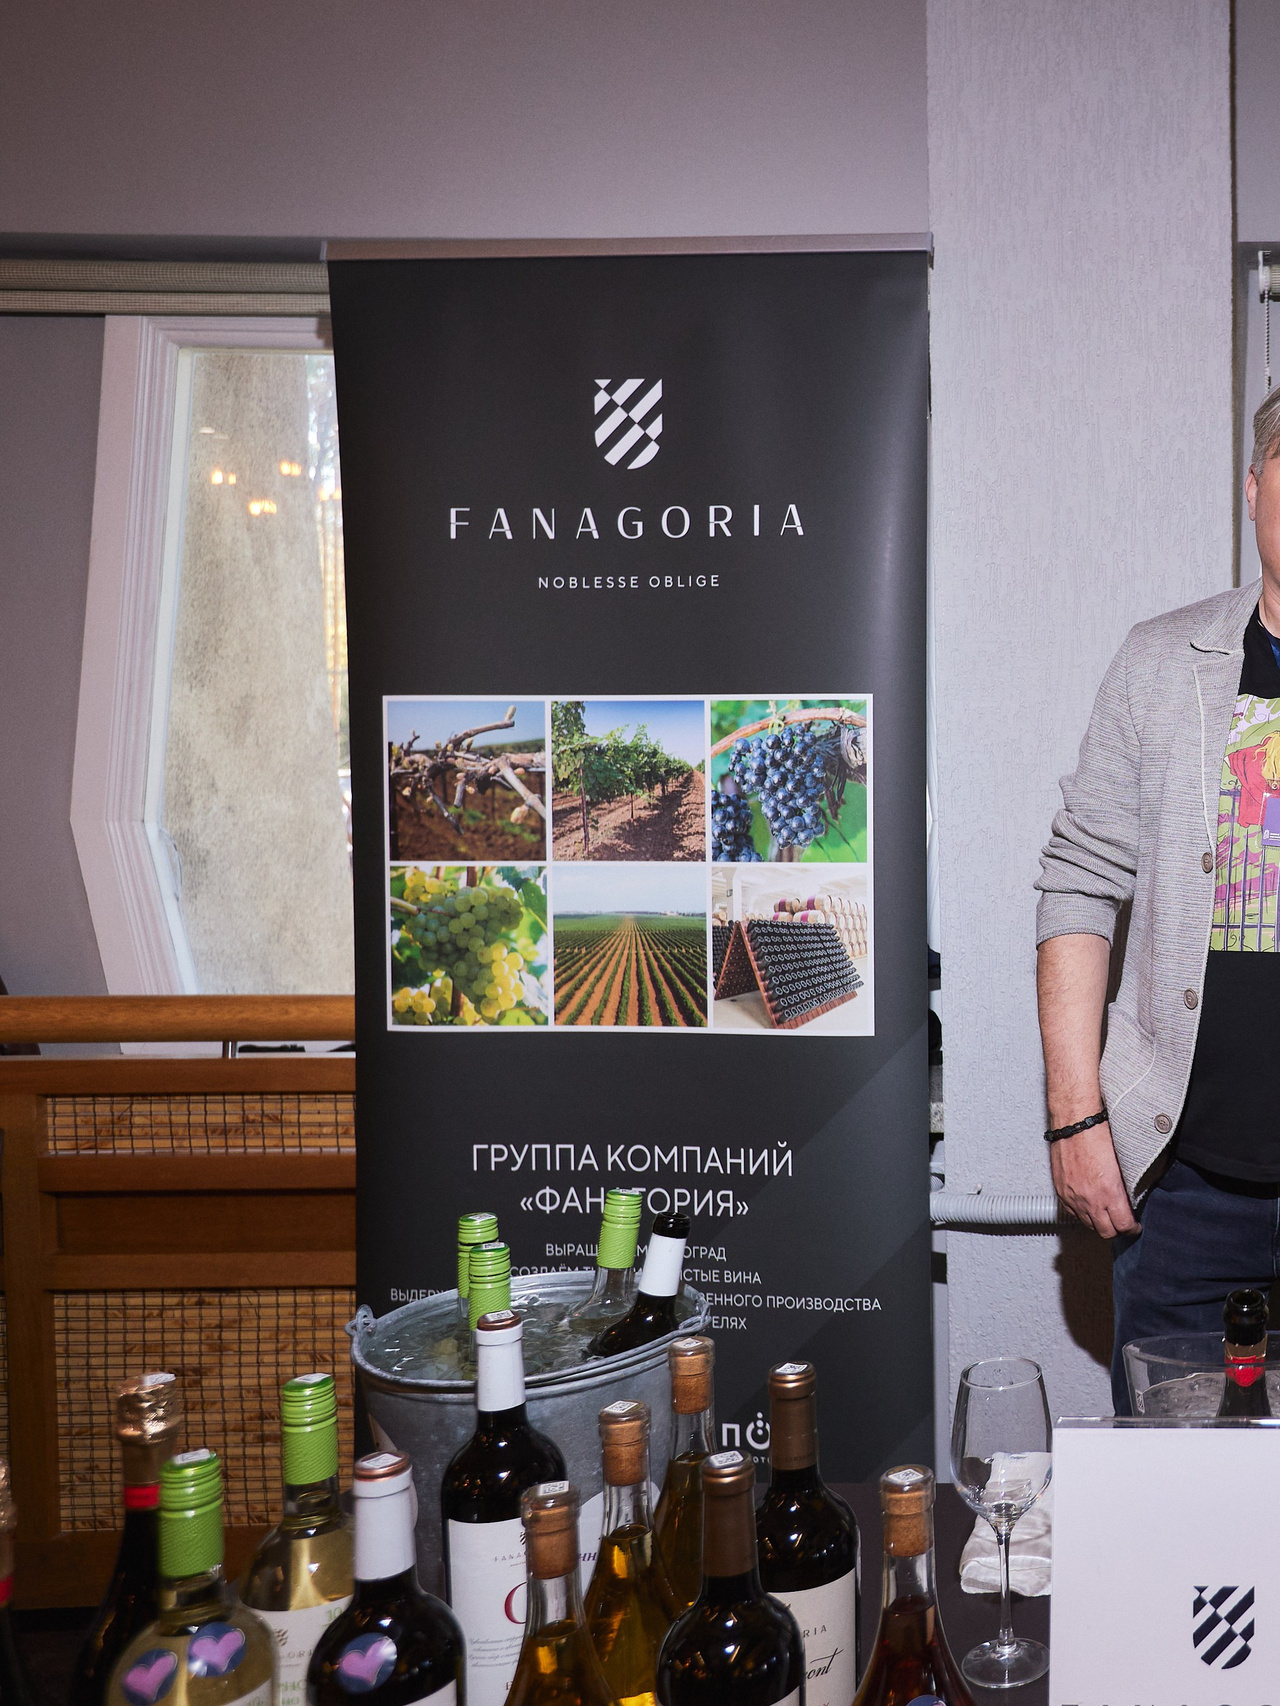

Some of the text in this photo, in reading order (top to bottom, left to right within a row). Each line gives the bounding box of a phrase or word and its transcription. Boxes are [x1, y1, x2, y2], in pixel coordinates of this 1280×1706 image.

[450, 503, 804, 540] FANAGORIA
[538, 574, 719, 589] NOBLESSE OBLIGE
[473, 1141, 792, 1176] ГРУППА КОМПАНИЙ
[520, 1186, 749, 1217] «ФАНОРИЯ»
[724, 1270, 762, 1285] ВИНА
[766, 1295, 882, 1313] ПРОИЗВОДСТВА
